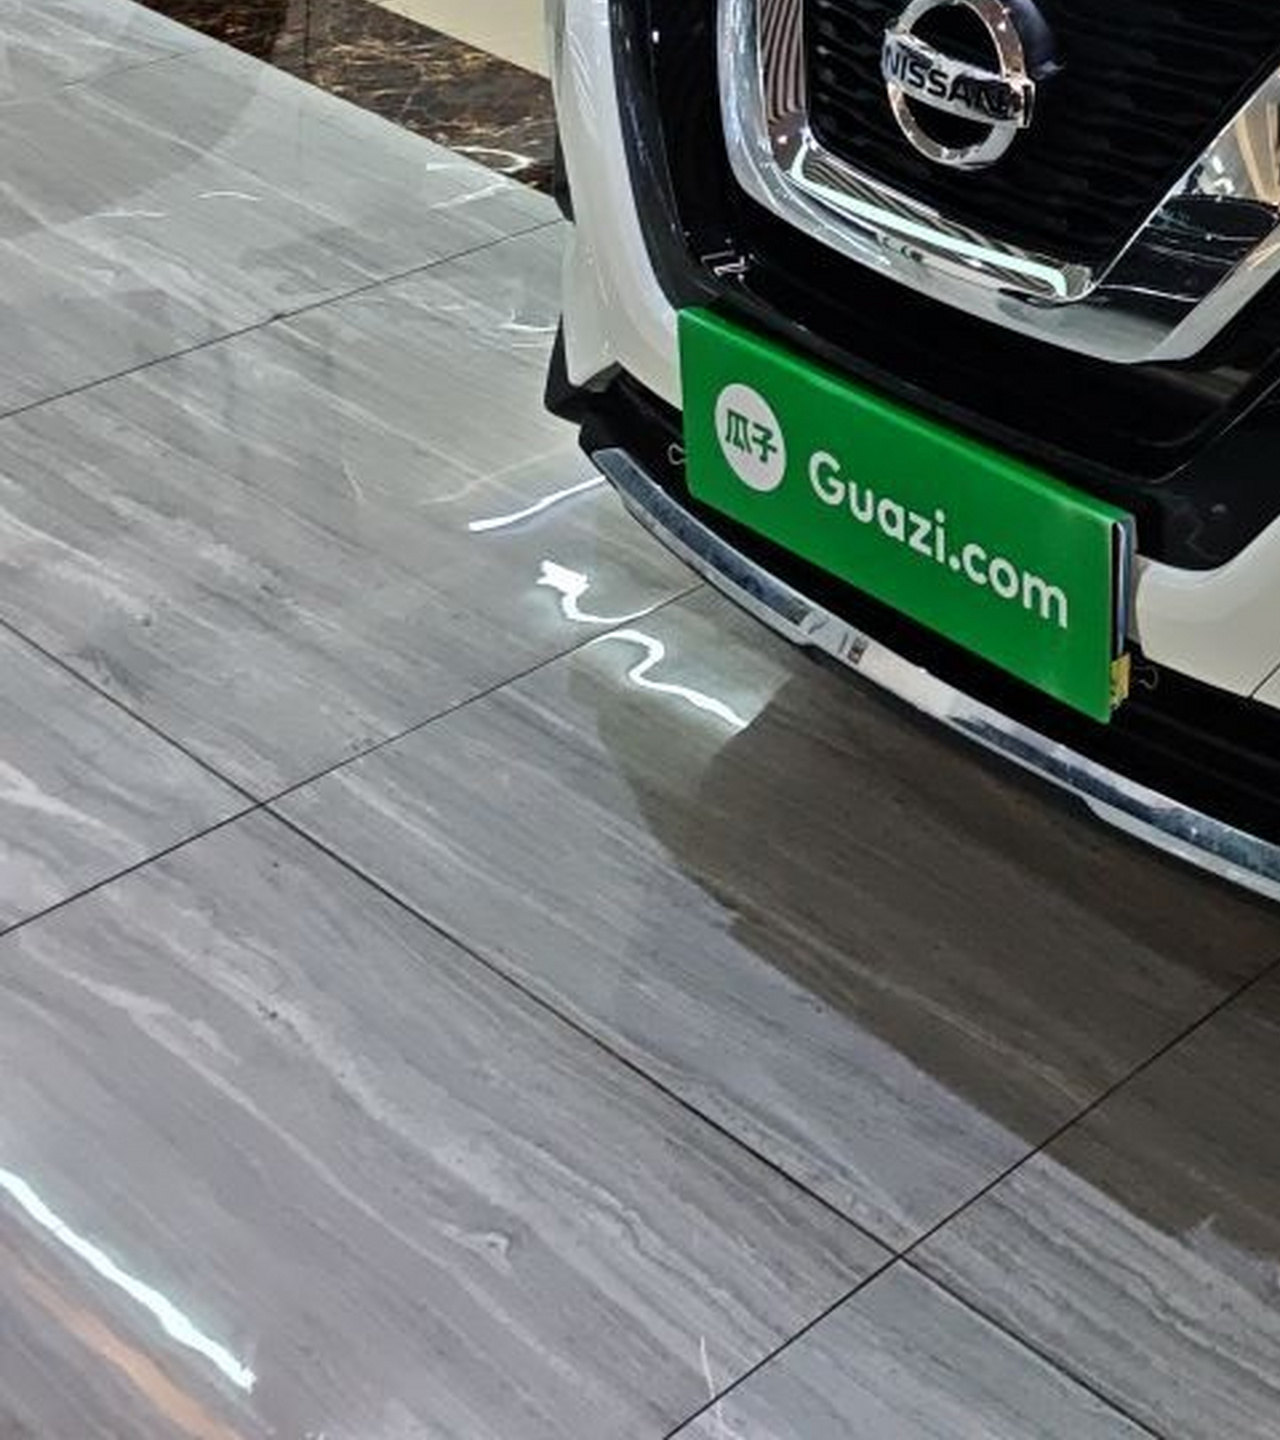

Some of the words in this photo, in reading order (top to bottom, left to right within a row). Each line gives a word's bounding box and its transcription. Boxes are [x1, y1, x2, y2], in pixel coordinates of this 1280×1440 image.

[884, 42, 1006, 118] NISSAN
[725, 409, 777, 463] 瓜子
[808, 450, 1068, 629] Guazi.com
